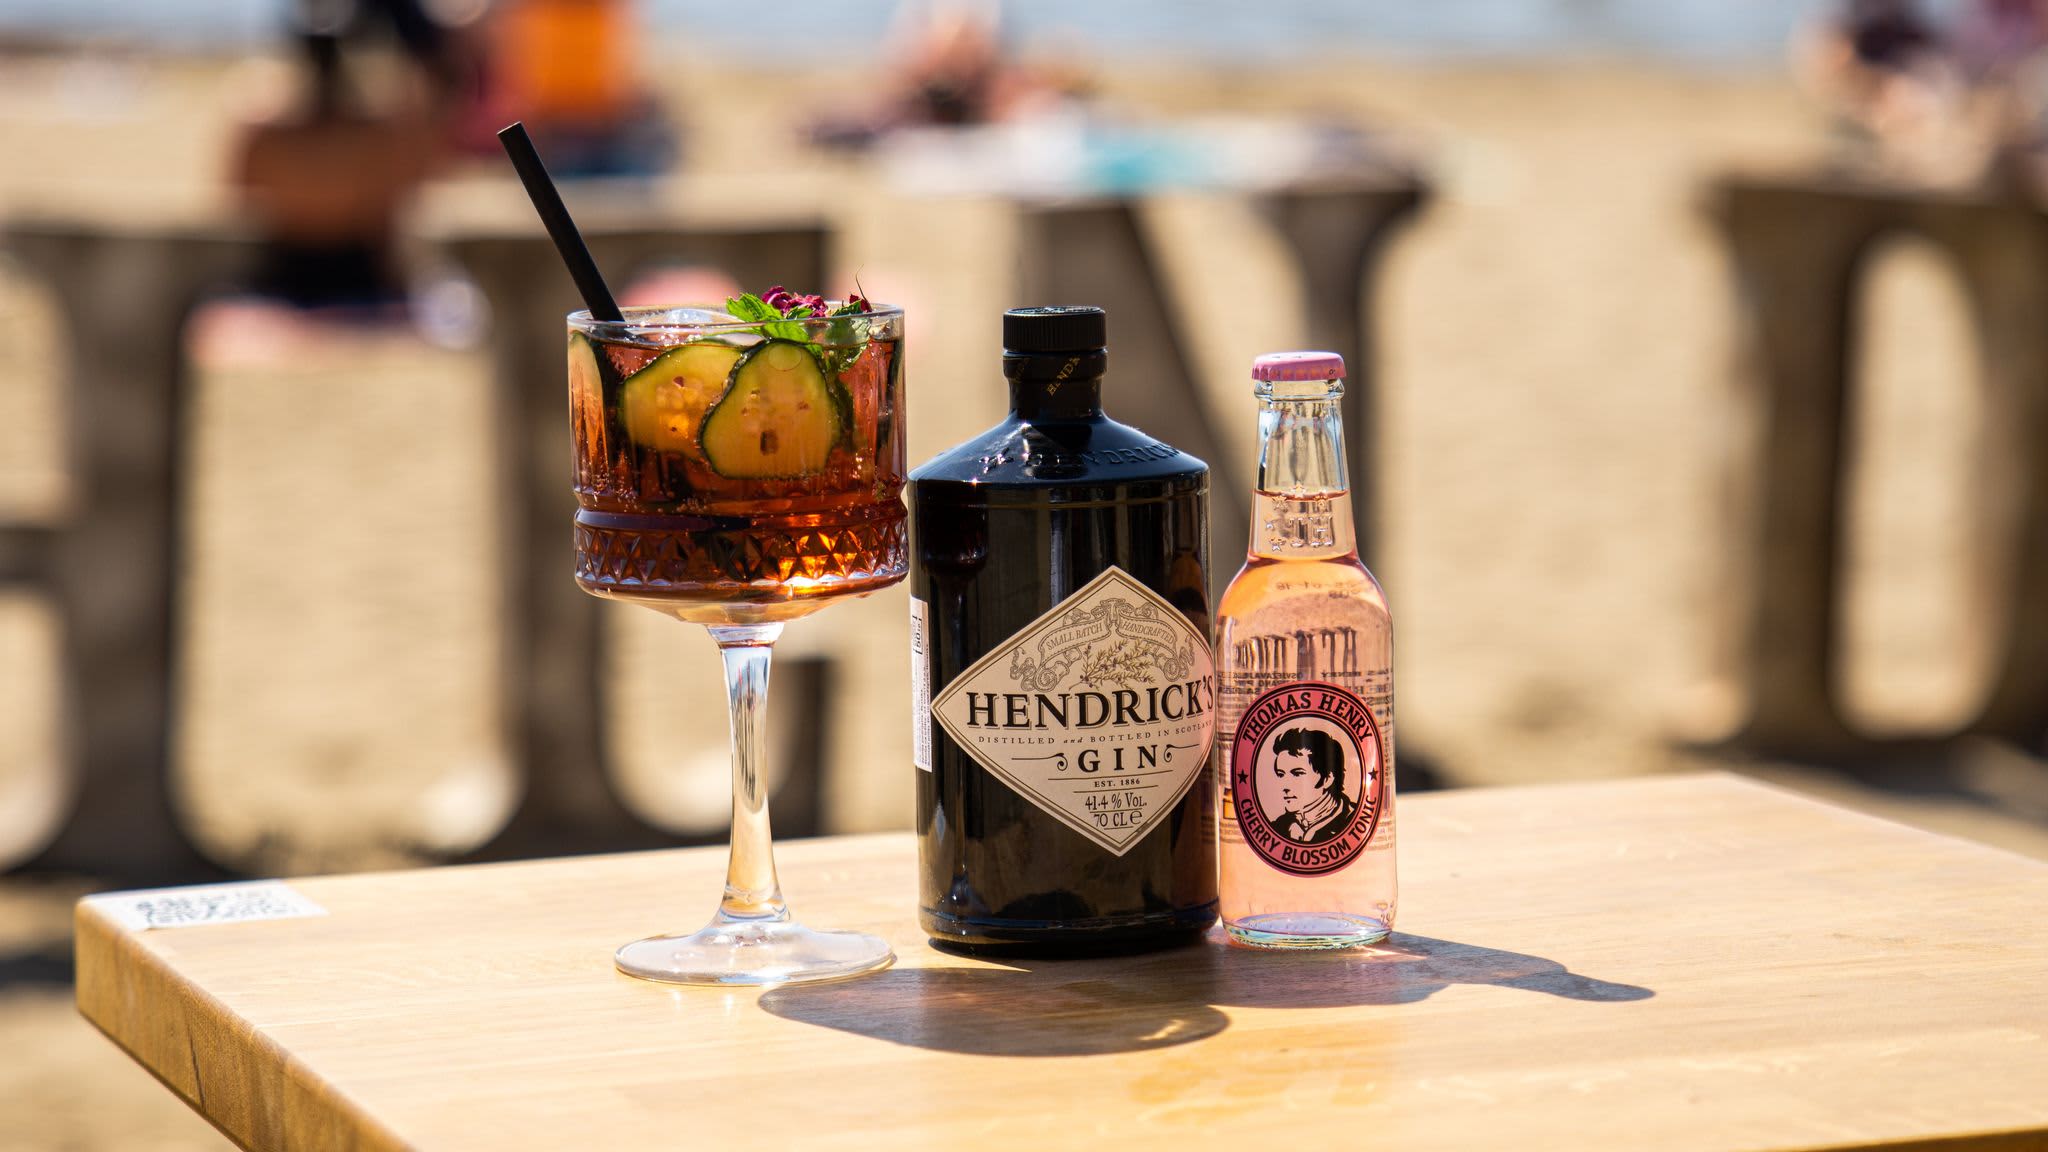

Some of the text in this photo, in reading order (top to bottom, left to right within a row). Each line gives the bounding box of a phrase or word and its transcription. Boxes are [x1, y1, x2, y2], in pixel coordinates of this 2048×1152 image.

[1046, 622, 1103, 651] SMALL BATCH
[1122, 620, 1177, 645] HANDCRAFTED
[966, 676, 1215, 730] HENDRICK'S
[978, 736, 1056, 745] DISTILLED
[1090, 731, 1152, 743] BOTTLED
[1157, 729, 1170, 737] IN
[1175, 719, 1213, 735] SCOTLAND
[1243, 692, 1309, 745] THOMAS
[1318, 693, 1373, 743] HENRY
[1077, 744, 1158, 773] GIN
[1120, 778, 1141, 786] 1886
[1084, 798, 1109, 811] 41.4
[1111, 793, 1122, 807] %
[1093, 811, 1109, 828] 70
[1240, 797, 1281, 853] CHERRY
[1281, 840, 1351, 866] BLOSSOM
[1348, 795, 1377, 842] TONIC
